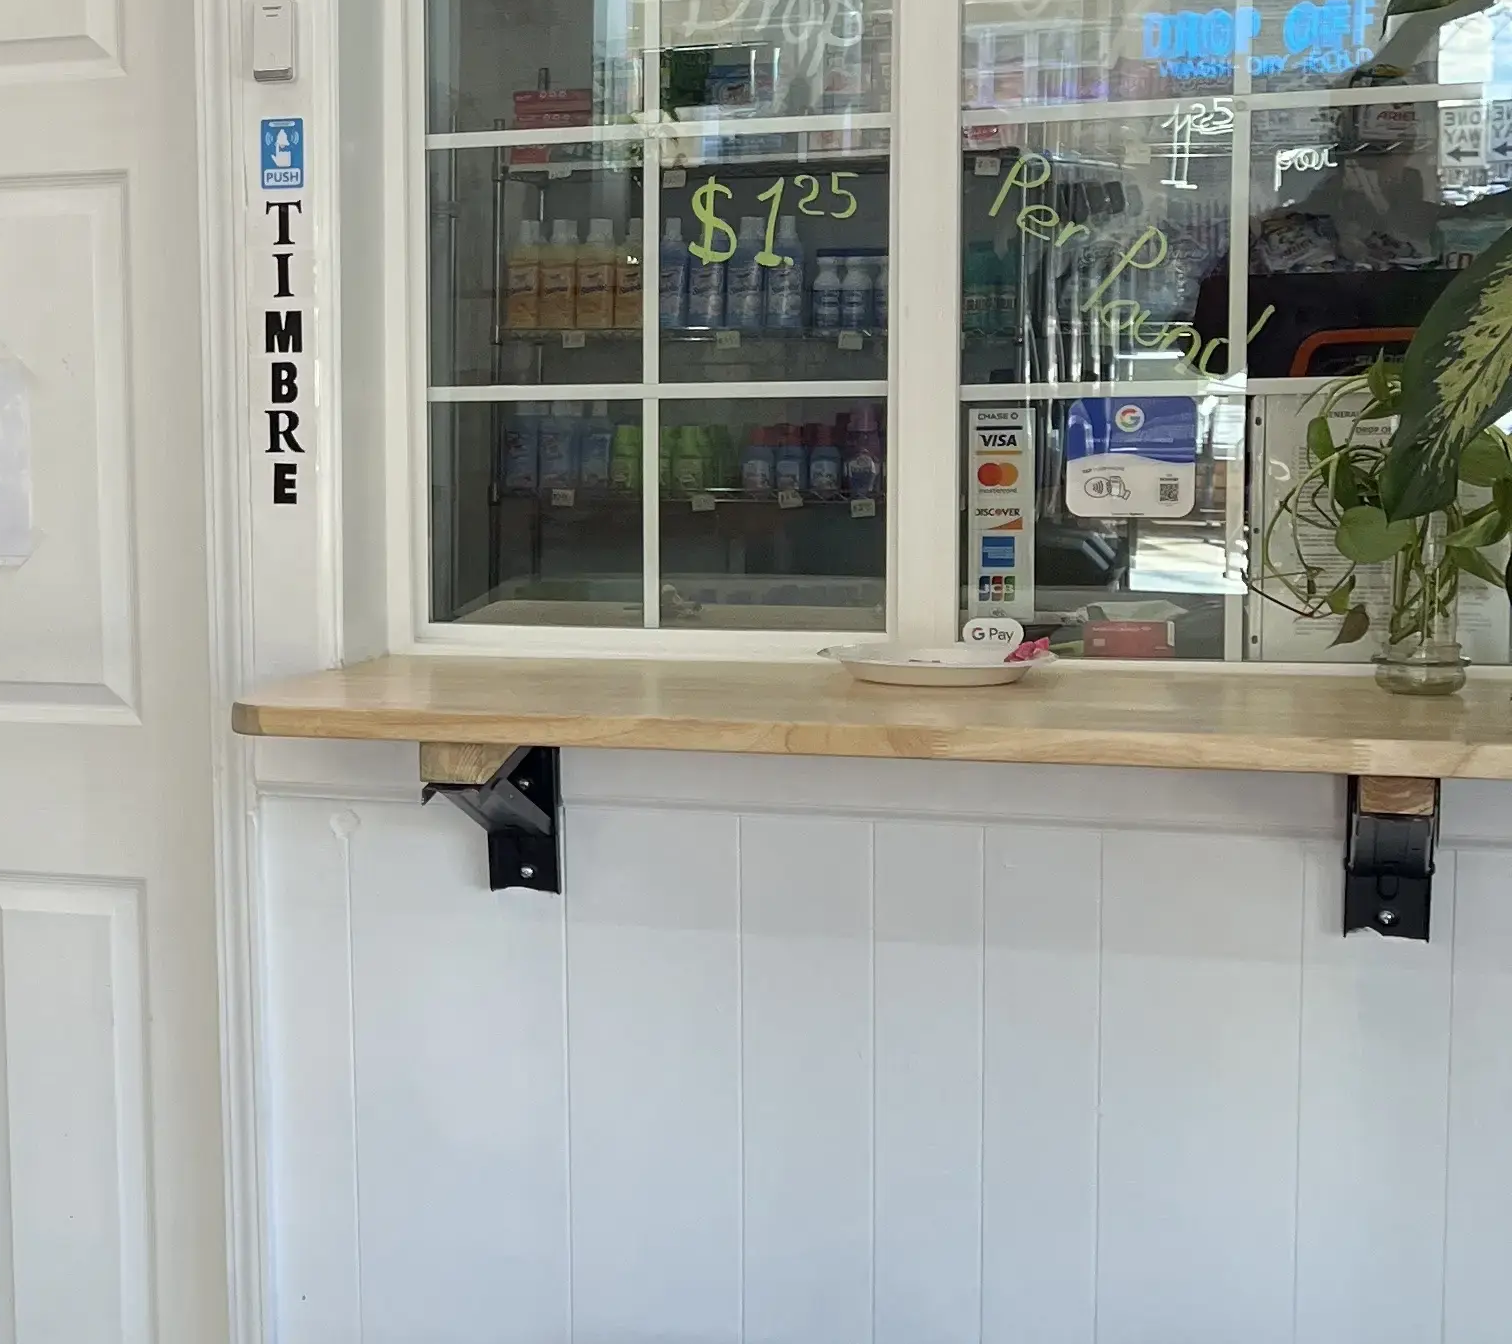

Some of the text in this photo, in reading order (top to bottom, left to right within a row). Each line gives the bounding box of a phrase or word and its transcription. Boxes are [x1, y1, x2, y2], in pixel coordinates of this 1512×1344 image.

[266, 170, 299, 184] PUSH
[988, 152, 1090, 248] Per
[264, 199, 305, 505] TIMBRE
[980, 435, 1017, 446] VISA
[975, 508, 1020, 516] DISCOVER
[989, 628, 1014, 643] Pay
